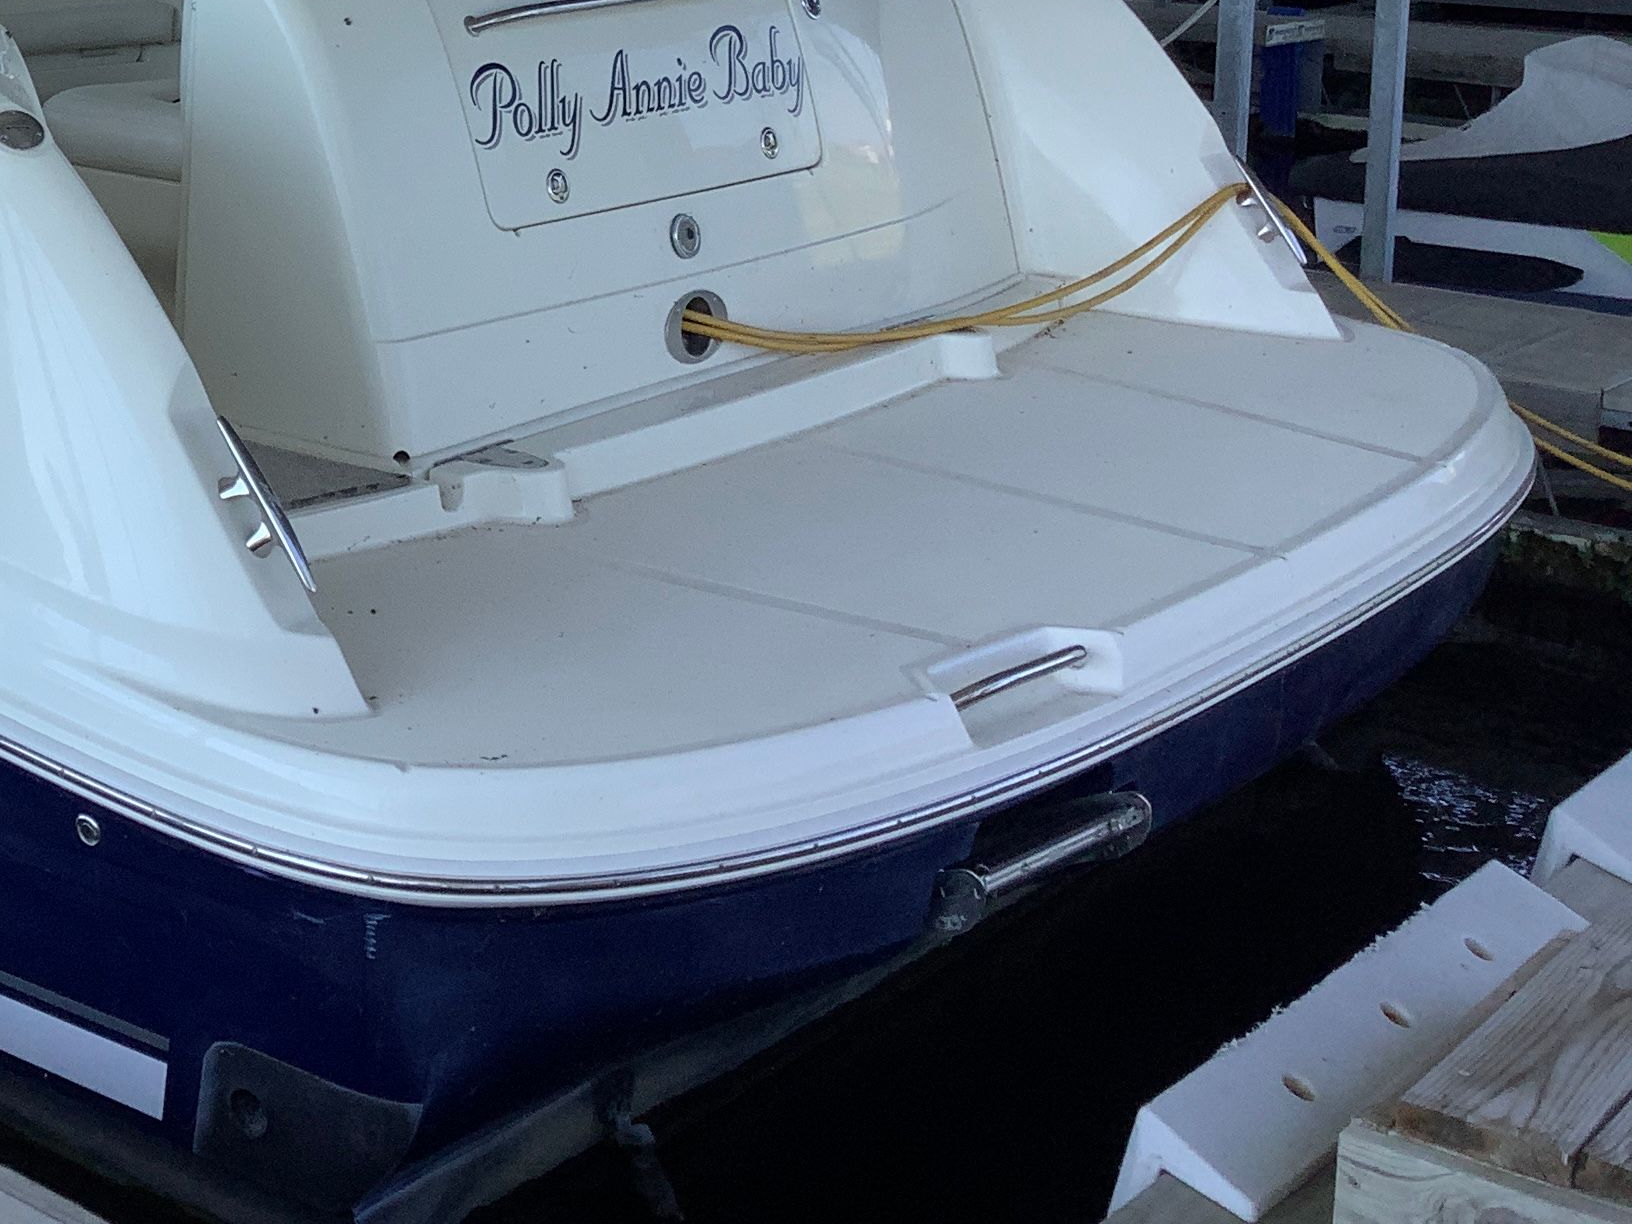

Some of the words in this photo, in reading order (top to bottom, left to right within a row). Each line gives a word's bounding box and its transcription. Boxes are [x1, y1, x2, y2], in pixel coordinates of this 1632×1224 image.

[470, 58, 582, 160] Polly
[589, 49, 707, 126] Annie
[709, 25, 804, 117] Baby
